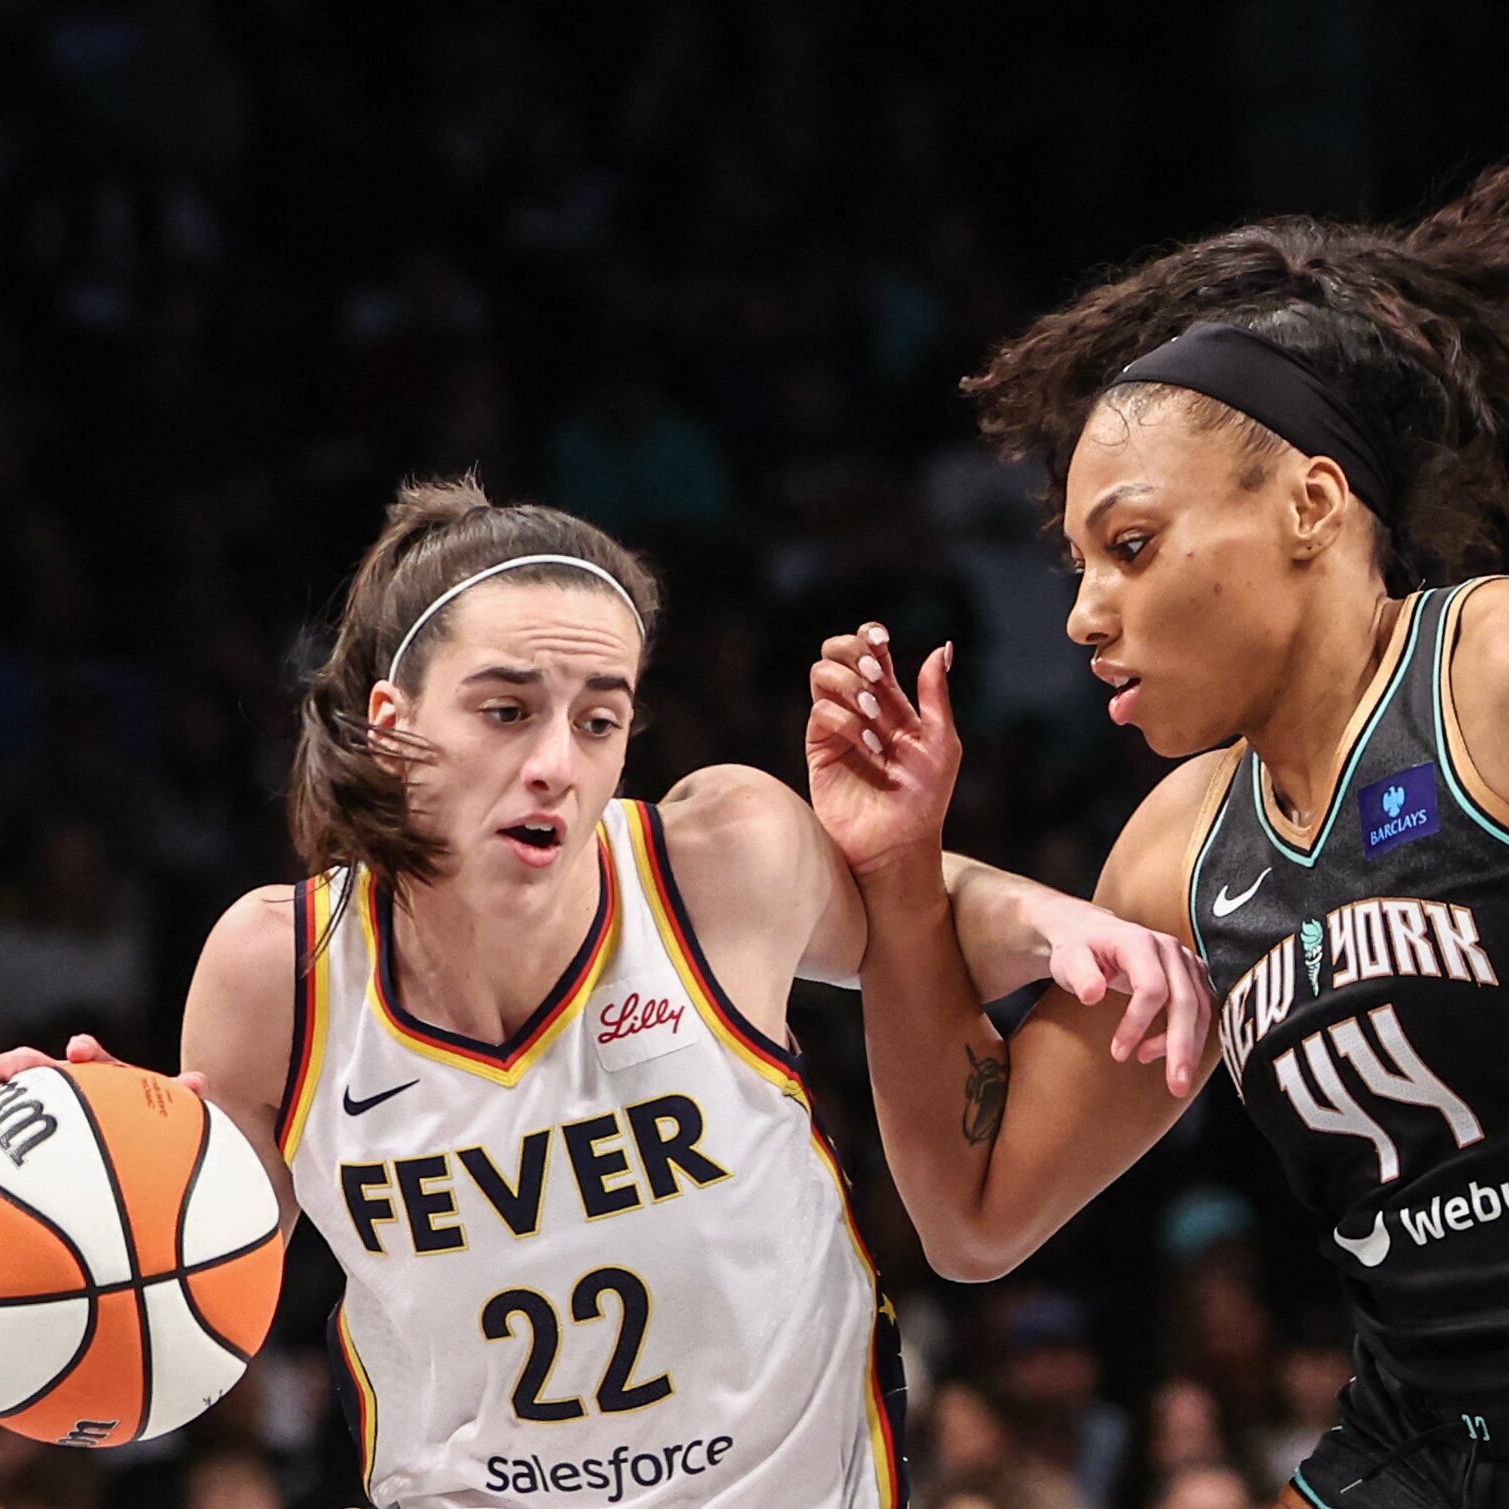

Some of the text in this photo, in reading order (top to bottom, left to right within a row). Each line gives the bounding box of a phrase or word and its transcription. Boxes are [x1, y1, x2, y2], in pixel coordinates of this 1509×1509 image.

[1370, 809, 1428, 846] BARCLAYS
[1326, 896, 1500, 989] YORK
[597, 992, 686, 1044] Lilly
[1272, 1003, 1486, 1184] 44
[339, 1093, 734, 1256] FEVER
[478, 1263, 677, 1425] 22
[485, 1435, 734, 1503] salesforce
